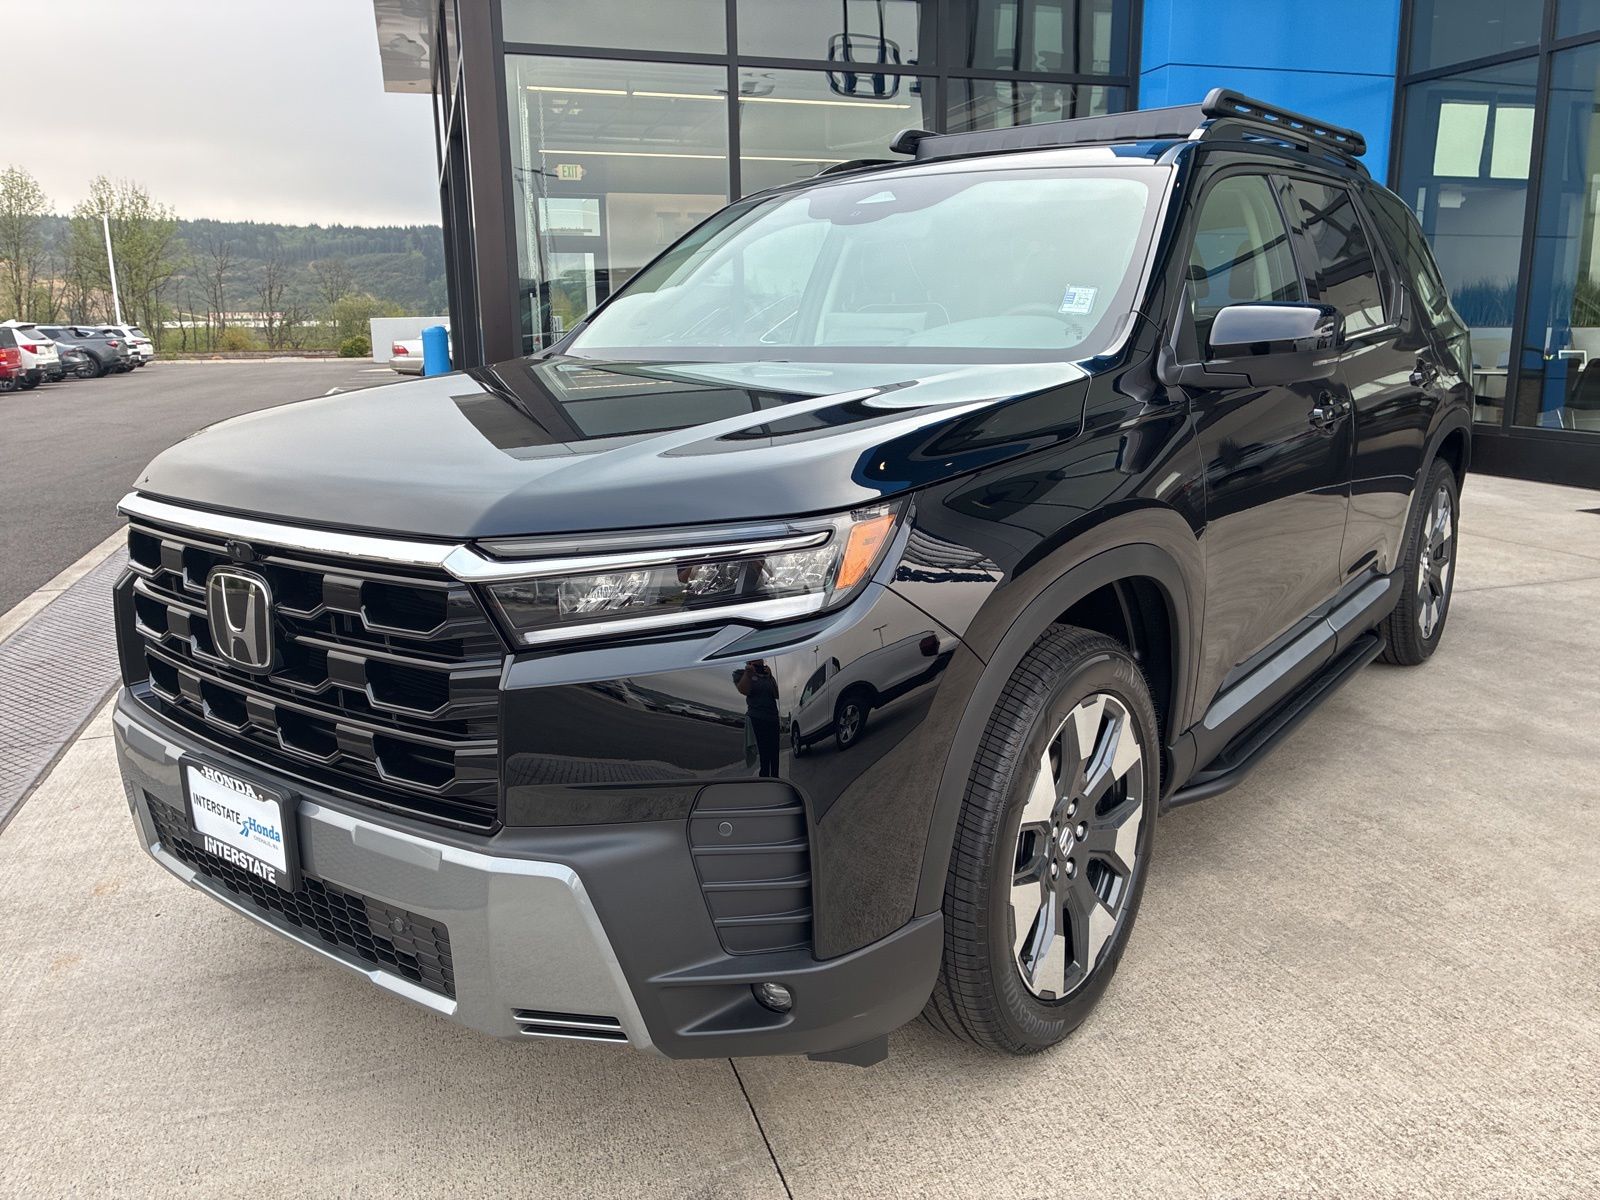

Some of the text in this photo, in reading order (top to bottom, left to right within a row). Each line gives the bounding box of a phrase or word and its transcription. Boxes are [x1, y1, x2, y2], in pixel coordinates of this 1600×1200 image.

[562, 165, 577, 178] EXIT
[202, 766, 258, 800] HONDA
[192, 791, 242, 825] INTERSTATE
[248, 816, 281, 842] Honda
[204, 835, 276, 884] INTERSTATE
